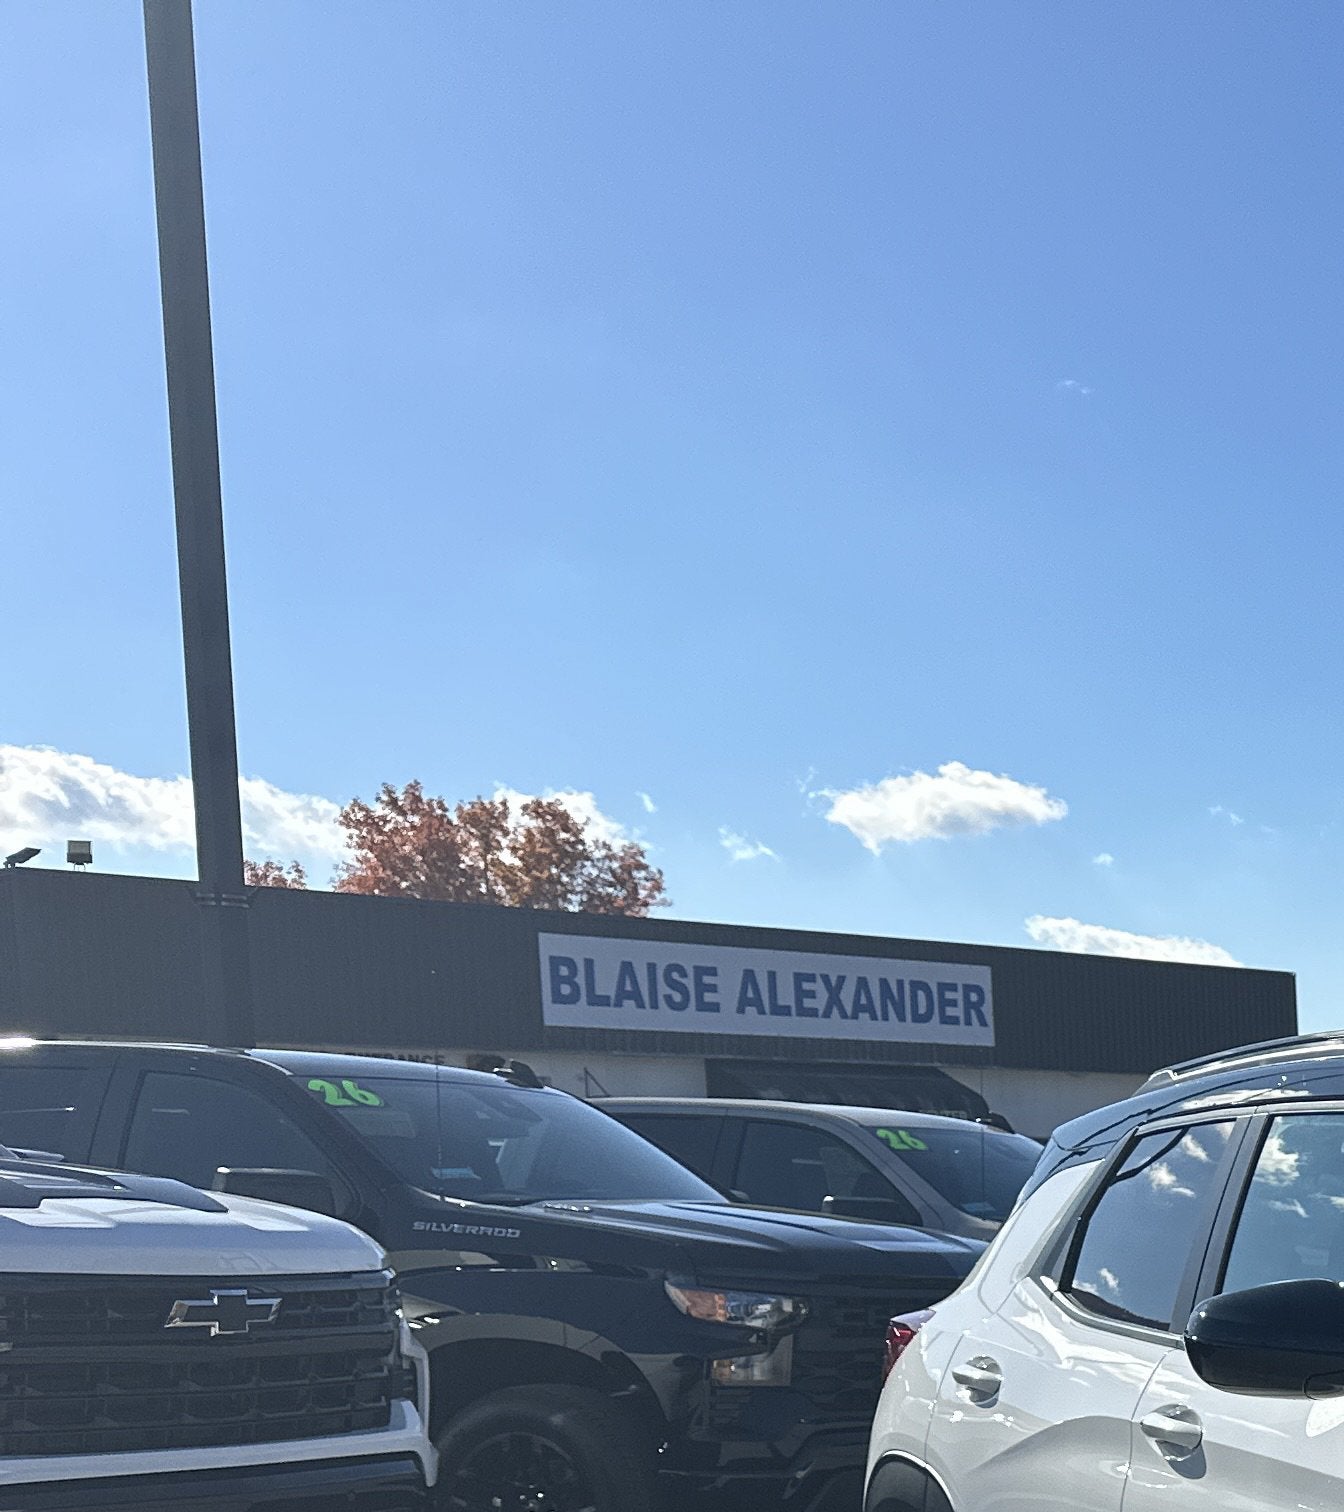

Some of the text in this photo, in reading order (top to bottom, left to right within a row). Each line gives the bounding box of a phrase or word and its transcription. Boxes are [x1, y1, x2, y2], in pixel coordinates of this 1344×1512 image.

[547, 954, 989, 1028] BLAISE ALEXANDER
[307, 1079, 384, 1107] 26
[875, 1128, 929, 1151] 26
[412, 1220, 522, 1238] SILVERADO
